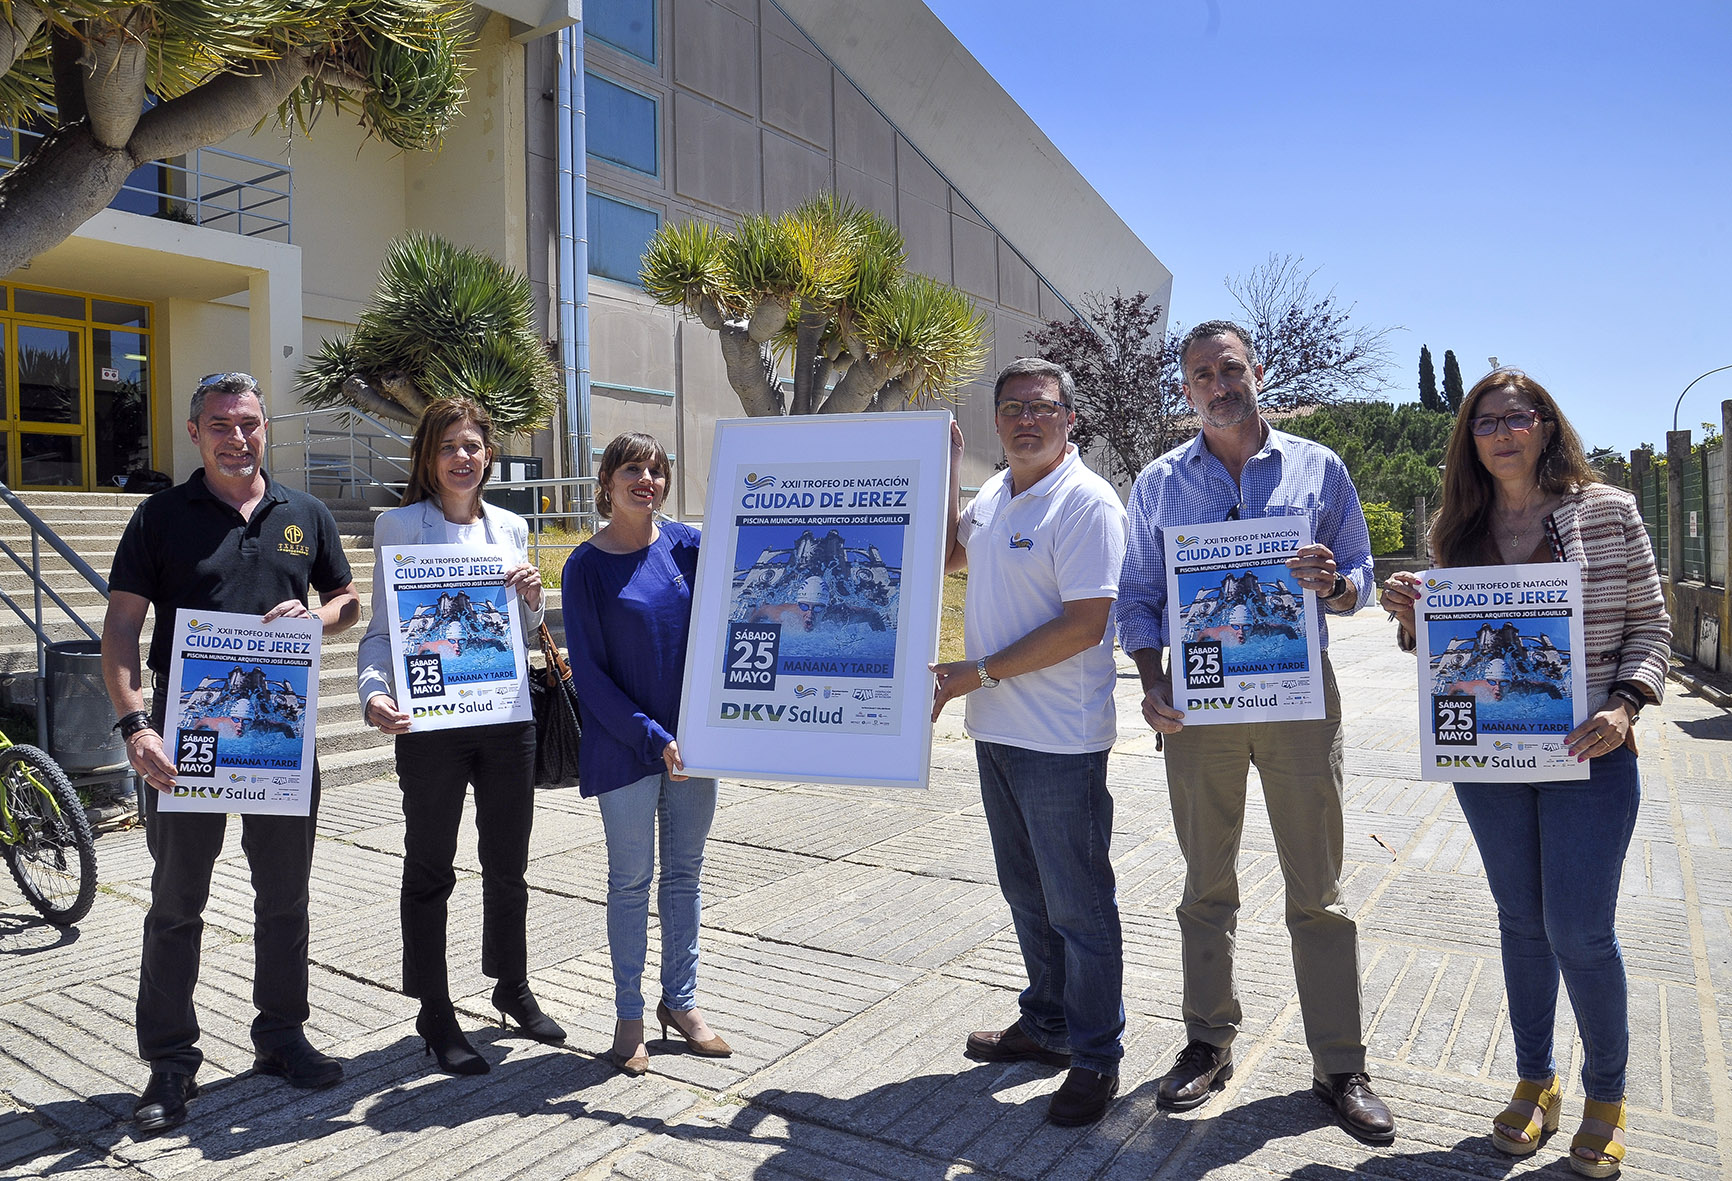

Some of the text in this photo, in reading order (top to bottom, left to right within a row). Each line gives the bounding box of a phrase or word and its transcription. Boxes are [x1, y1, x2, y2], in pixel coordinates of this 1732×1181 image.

[857, 476, 908, 486] NATACIÓN
[742, 491, 907, 509] CIUDAD DE JEREZ
[1261, 529, 1299, 539] NATACIÓN
[1176, 540, 1299, 562] CIUDAD DE JEREZ
[395, 565, 504, 579] CIUDAD DE JEREZ
[1523, 578, 1567, 587] NATACIÓN
[1427, 590, 1568, 608] CIUDAD DE JEREZ
[735, 629, 776, 641] SÁBADO
[186, 635, 310, 654] CIUDAD DE JEREZ
[1188, 646, 1218, 655] SÁBADO
[732, 641, 773, 669] 25
[410, 658, 438, 667] SÁBADO
[784, 659, 888, 674] MAÑANA Y TARDE
[1189, 655, 1220, 675] 25
[1228, 664, 1268, 673] MAÑANA
[411, 666, 440, 685] 25
[448, 672, 482, 682] MAÑANA
[729, 671, 771, 683] MAYO
[1190, 675, 1220, 684] MAYO
[413, 685, 441, 694] MAYO
[1188, 697, 1234, 710] DKV
[1238, 694, 1277, 708] Salud
[1439, 700, 1472, 708] SÁBADO
[413, 704, 456, 718] DKV
[458, 700, 493, 713] Salud
[720, 703, 843, 724] DKV Salud
[1439, 709, 1473, 730] 25
[1482, 722, 1526, 731] MAÑANA
[183, 734, 214, 742] SÁBADO
[1439, 732, 1473, 741] MAYO
[181, 743, 213, 763] 25
[180, 763, 212, 772] MAYO
[221, 757, 261, 766] MAÑANA
[1436, 755, 1489, 767] DKV
[1492, 756, 1536, 768] Salud
[174, 786, 224, 798] DKV
[226, 788, 265, 800] Salud
